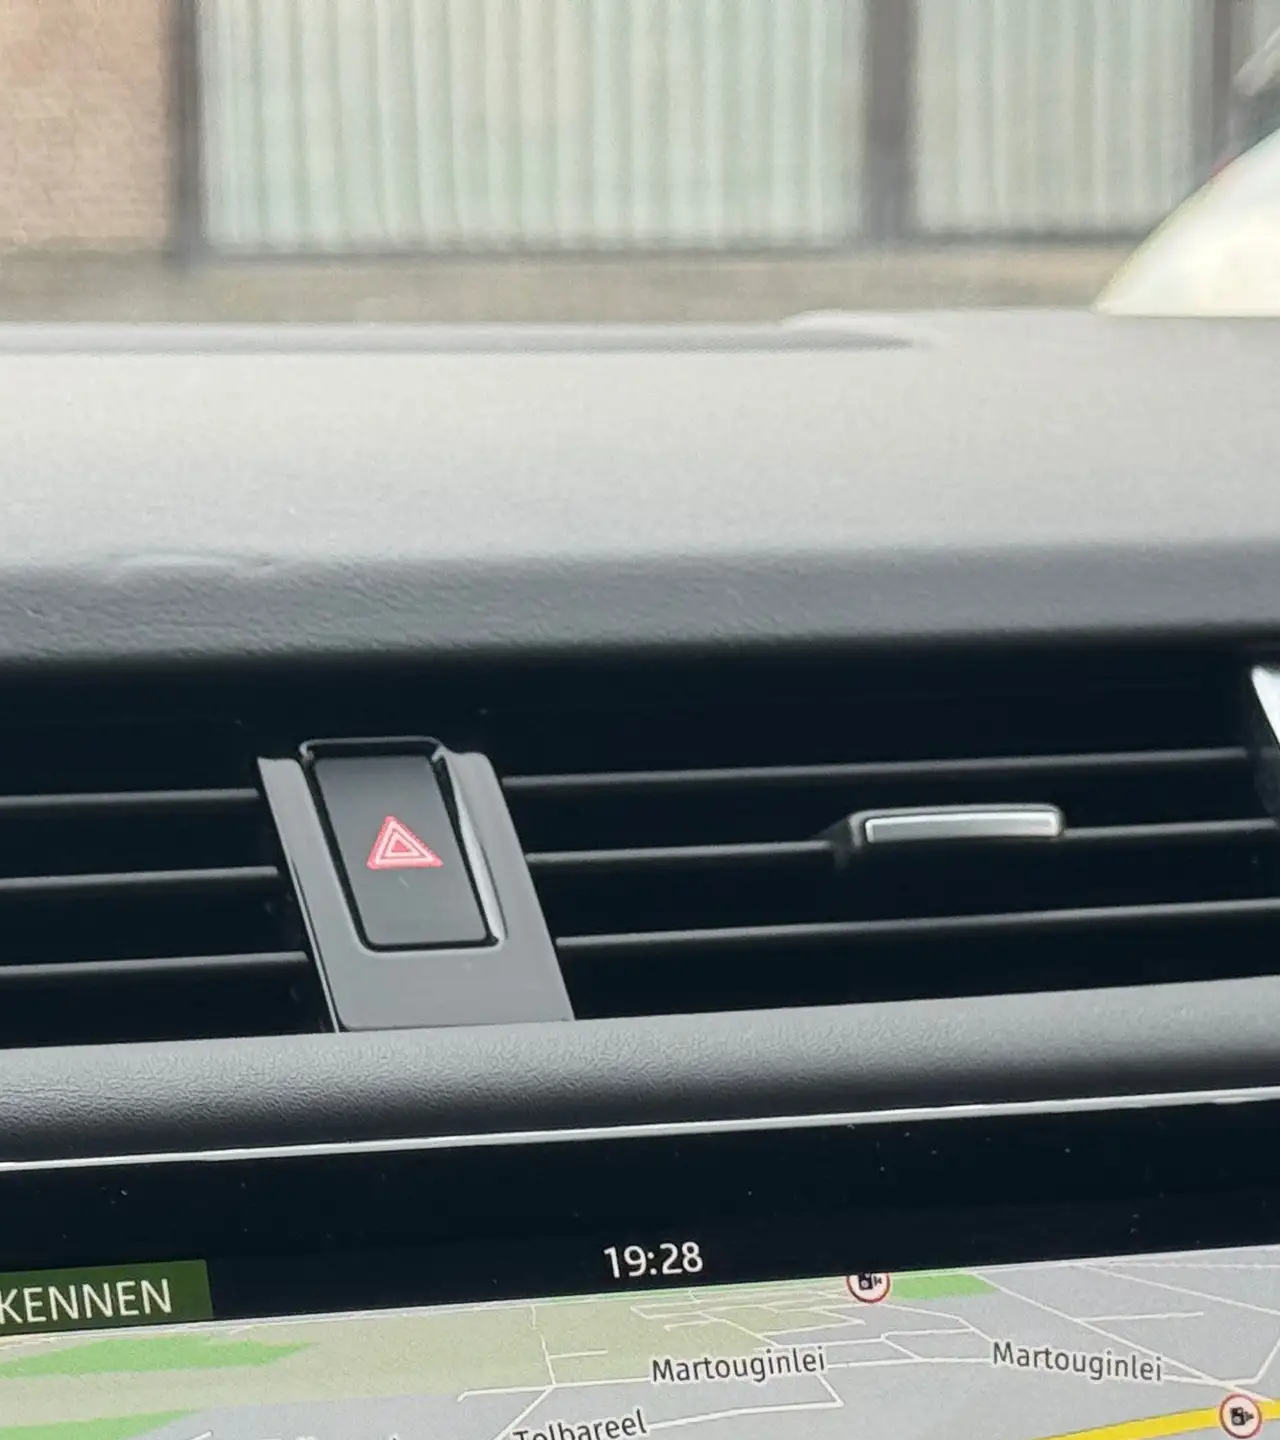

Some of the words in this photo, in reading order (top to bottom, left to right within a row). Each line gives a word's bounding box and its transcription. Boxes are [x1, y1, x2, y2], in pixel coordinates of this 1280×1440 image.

[604, 1242, 703, 1278] 19:28
[652, 1347, 826, 1384] Martouginlei
[992, 1341, 1163, 1384] Martouginlei
